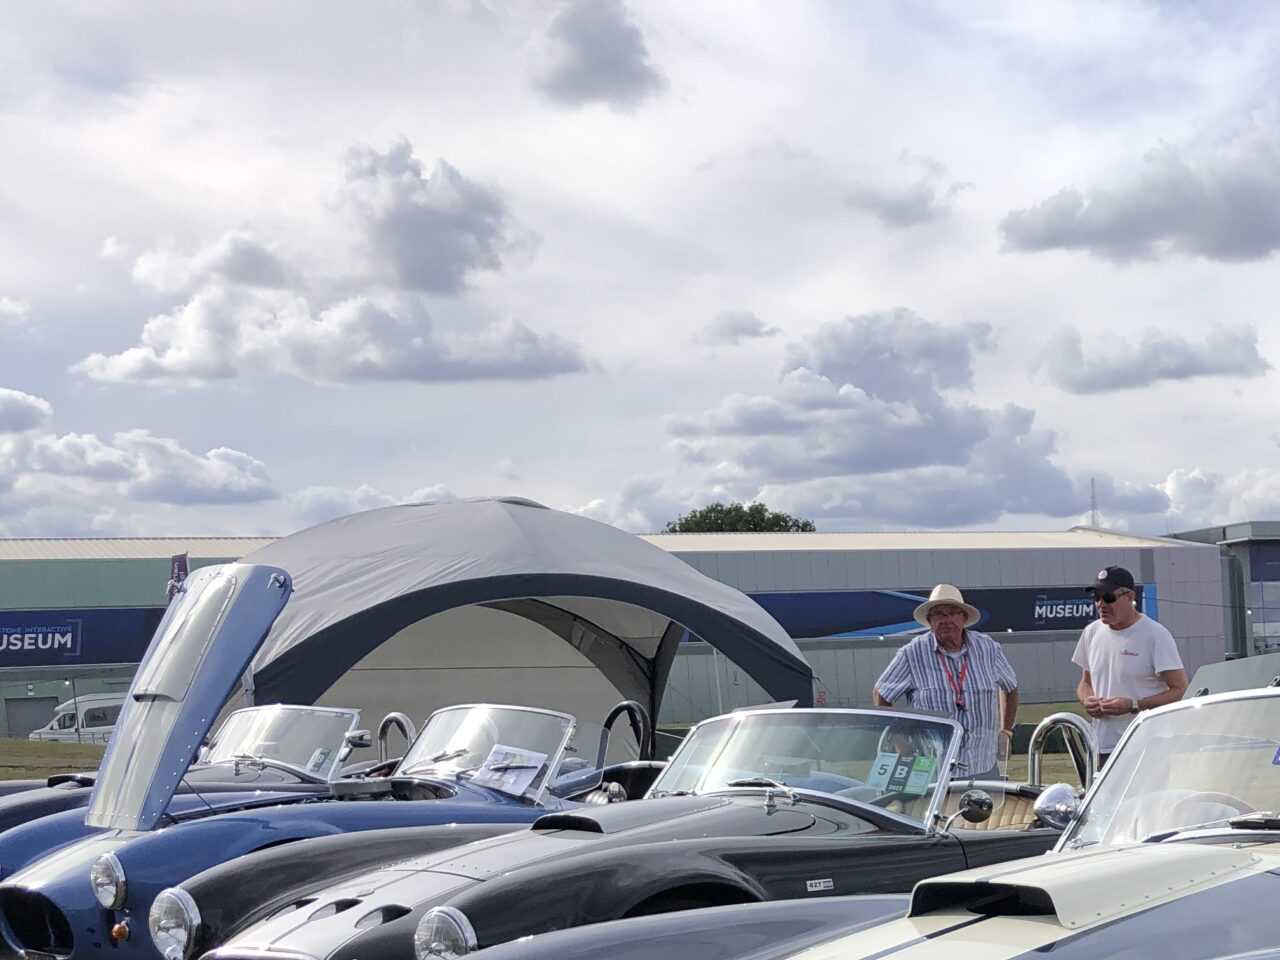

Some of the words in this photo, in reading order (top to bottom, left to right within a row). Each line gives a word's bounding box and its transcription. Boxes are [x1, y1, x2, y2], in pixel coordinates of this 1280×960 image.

[1034, 605, 1094, 618] MUSEUM
[877, 764, 889, 776] 5
[895, 765, 909, 778] B
